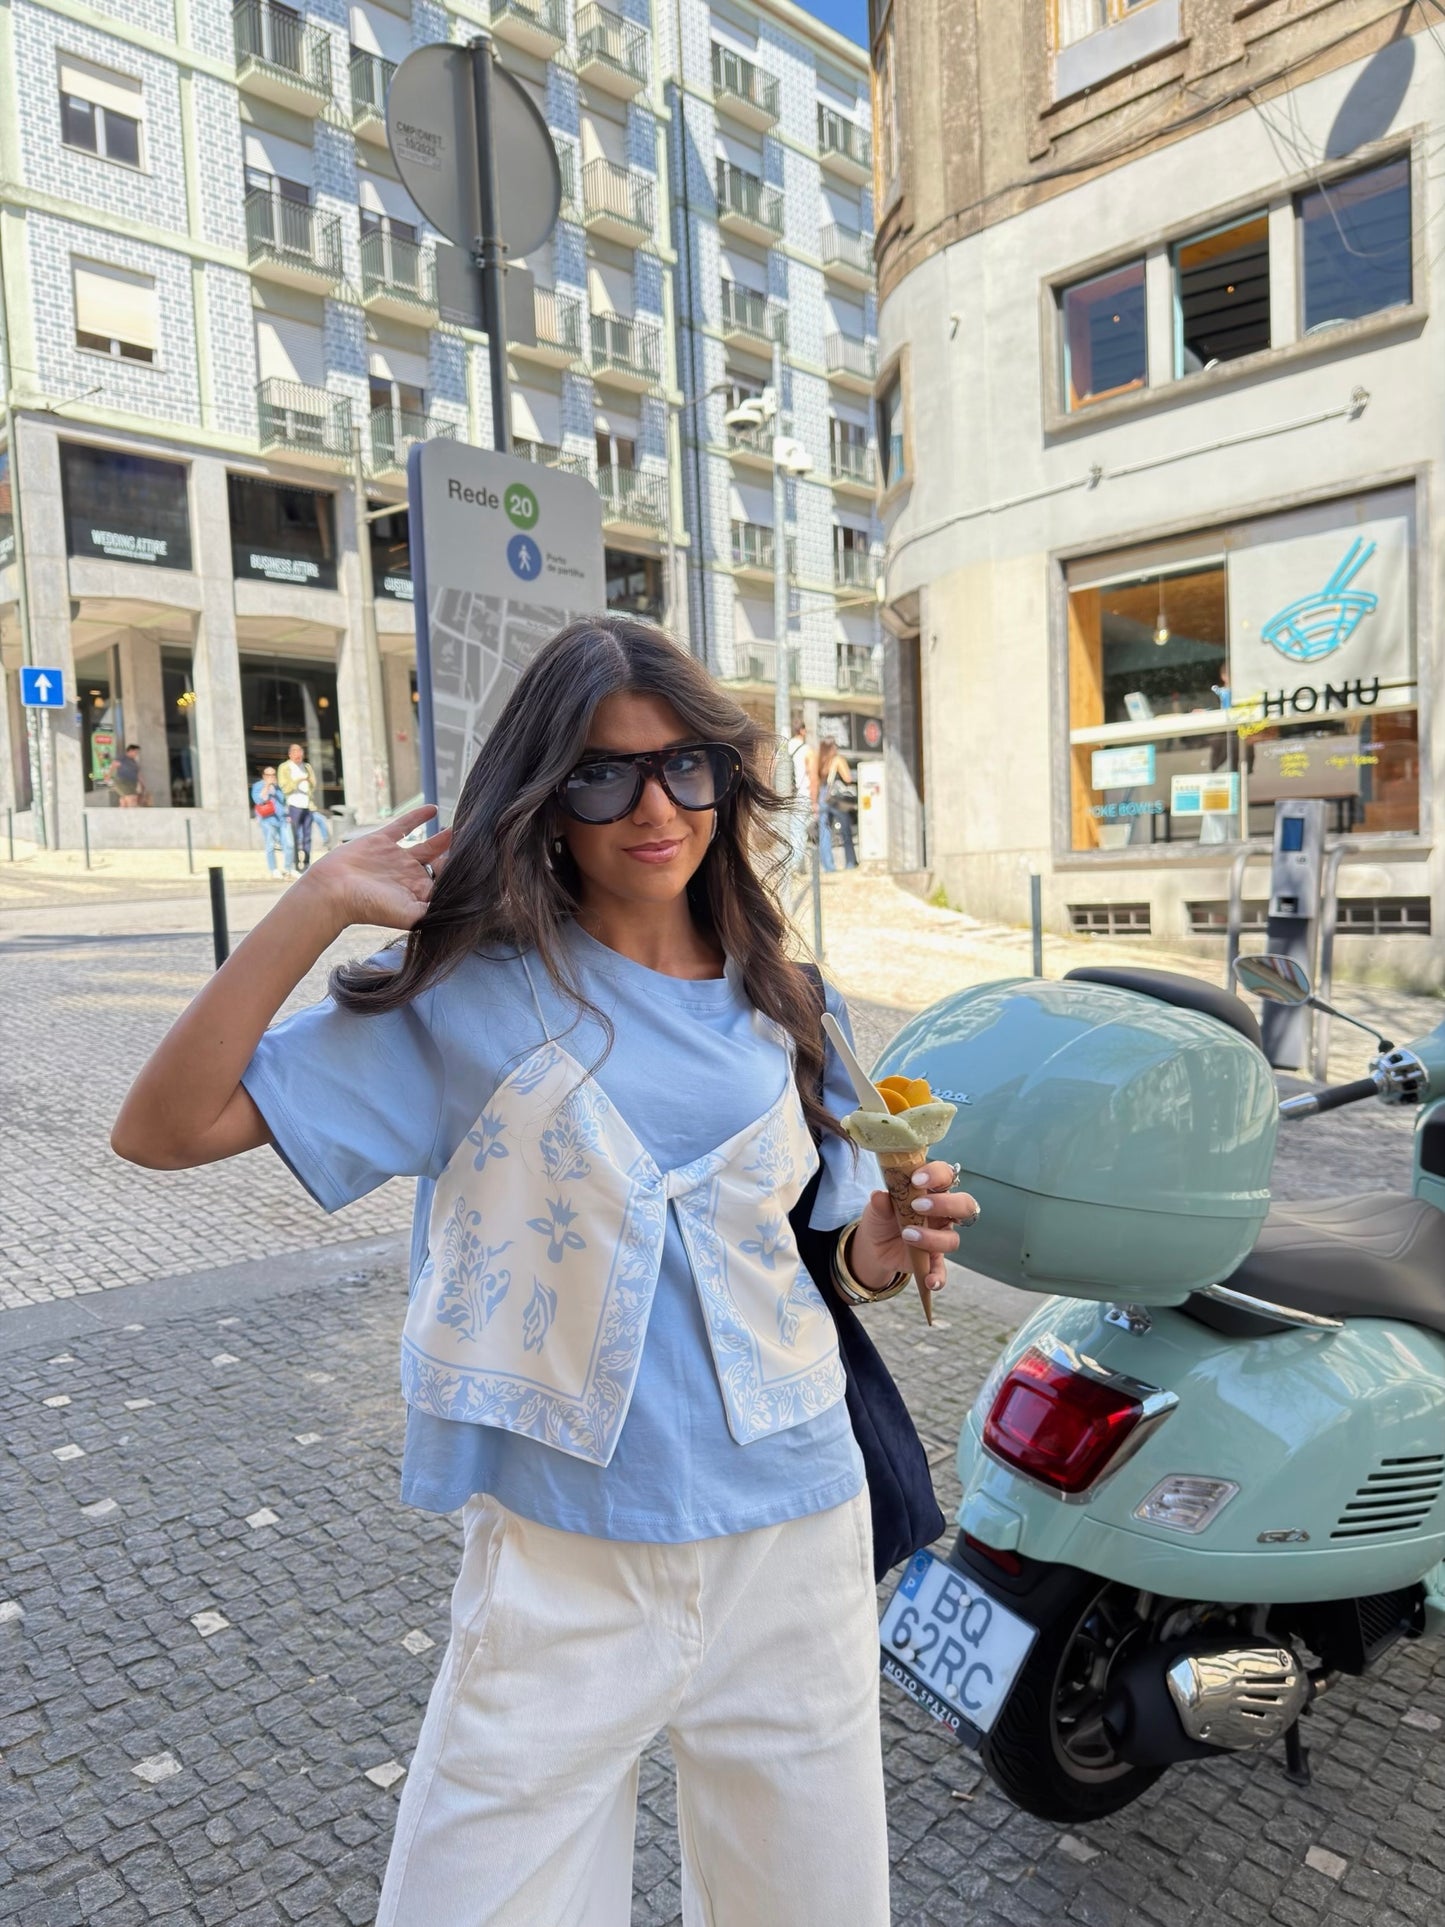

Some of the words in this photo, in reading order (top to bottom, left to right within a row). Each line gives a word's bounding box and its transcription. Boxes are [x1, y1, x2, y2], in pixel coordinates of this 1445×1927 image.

[447, 479, 500, 510] Rede
[509, 494, 533, 518] 20
[91, 529, 136, 551] WEDDING
[135, 537, 169, 556] ATTIRE
[250, 553, 292, 574] BUSINESS
[292, 560, 320, 578] ATTIRE
[1264, 677, 1380, 718] HONU
[1118, 799, 1165, 816] BOWLS
[904, 1578, 917, 1591] P
[931, 1574, 993, 1648] BQ
[891, 1606, 993, 1711] 62RC
[884, 1660, 918, 1693] MOTO
[919, 1691, 961, 1729] SPAZIO
